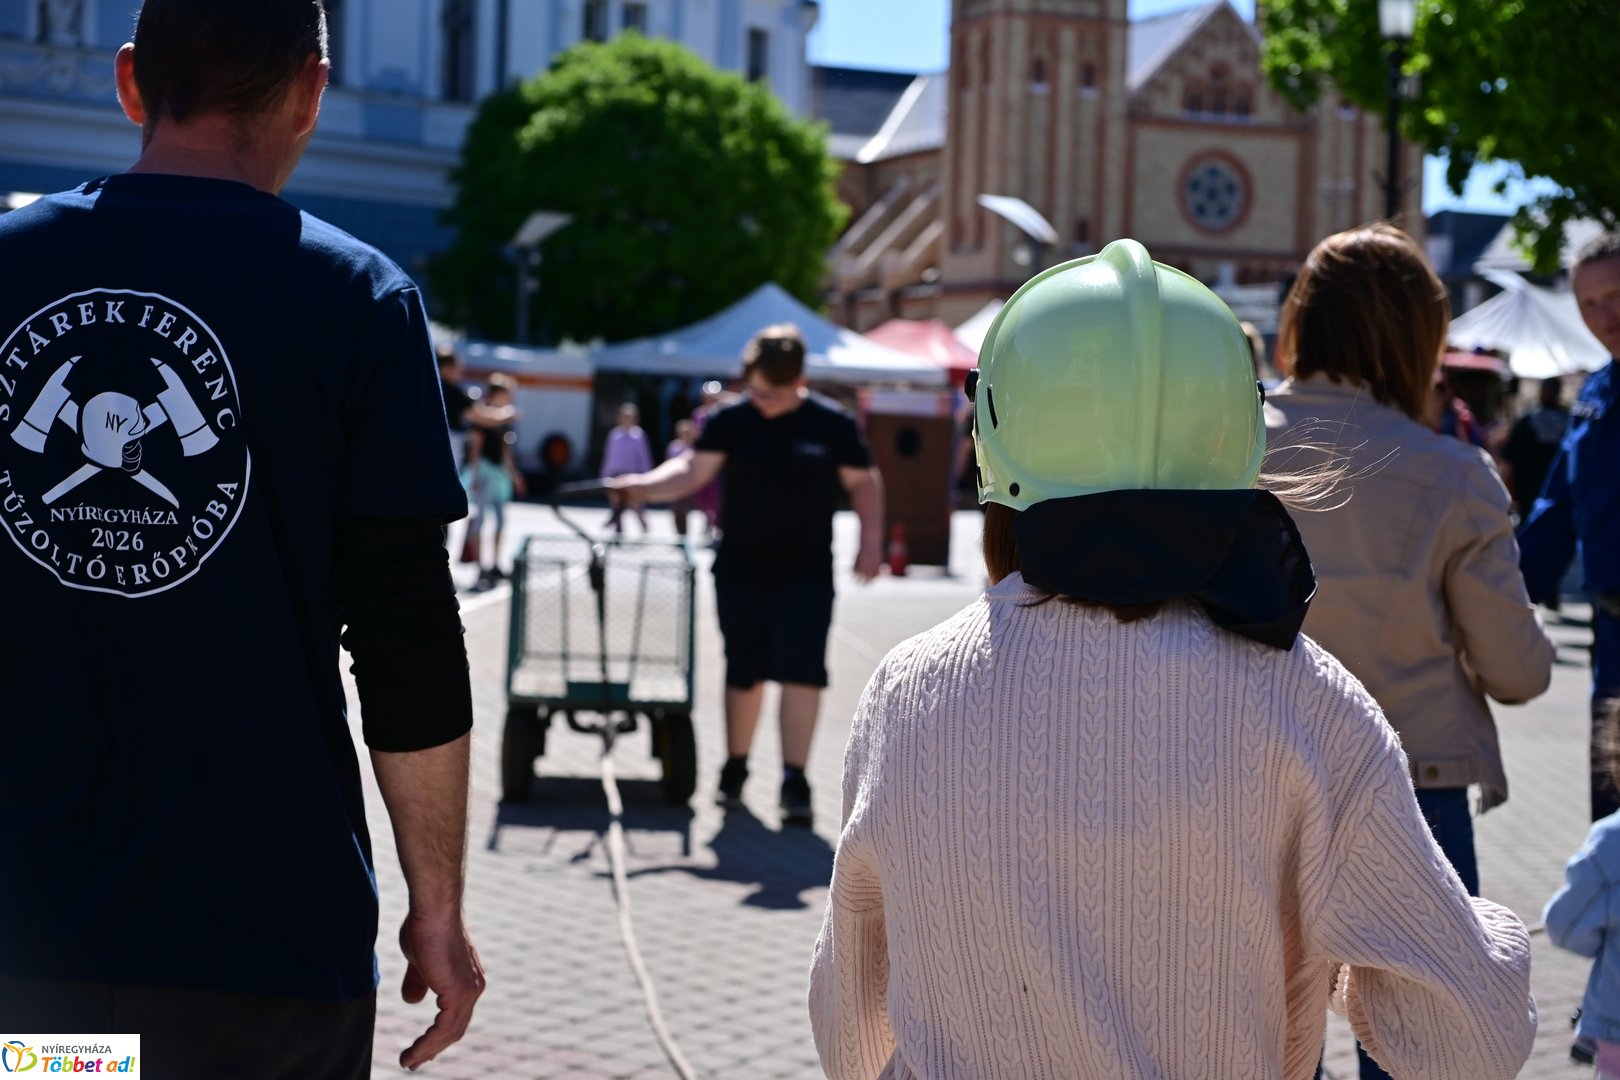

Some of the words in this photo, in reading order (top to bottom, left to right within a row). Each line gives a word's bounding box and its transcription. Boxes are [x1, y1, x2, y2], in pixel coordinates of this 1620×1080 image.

[138, 304, 236, 431] FERENC
[105, 411, 128, 433] NY
[50, 502, 179, 525] NYÍREGYHÁZA
[91, 527, 144, 551] 2026
